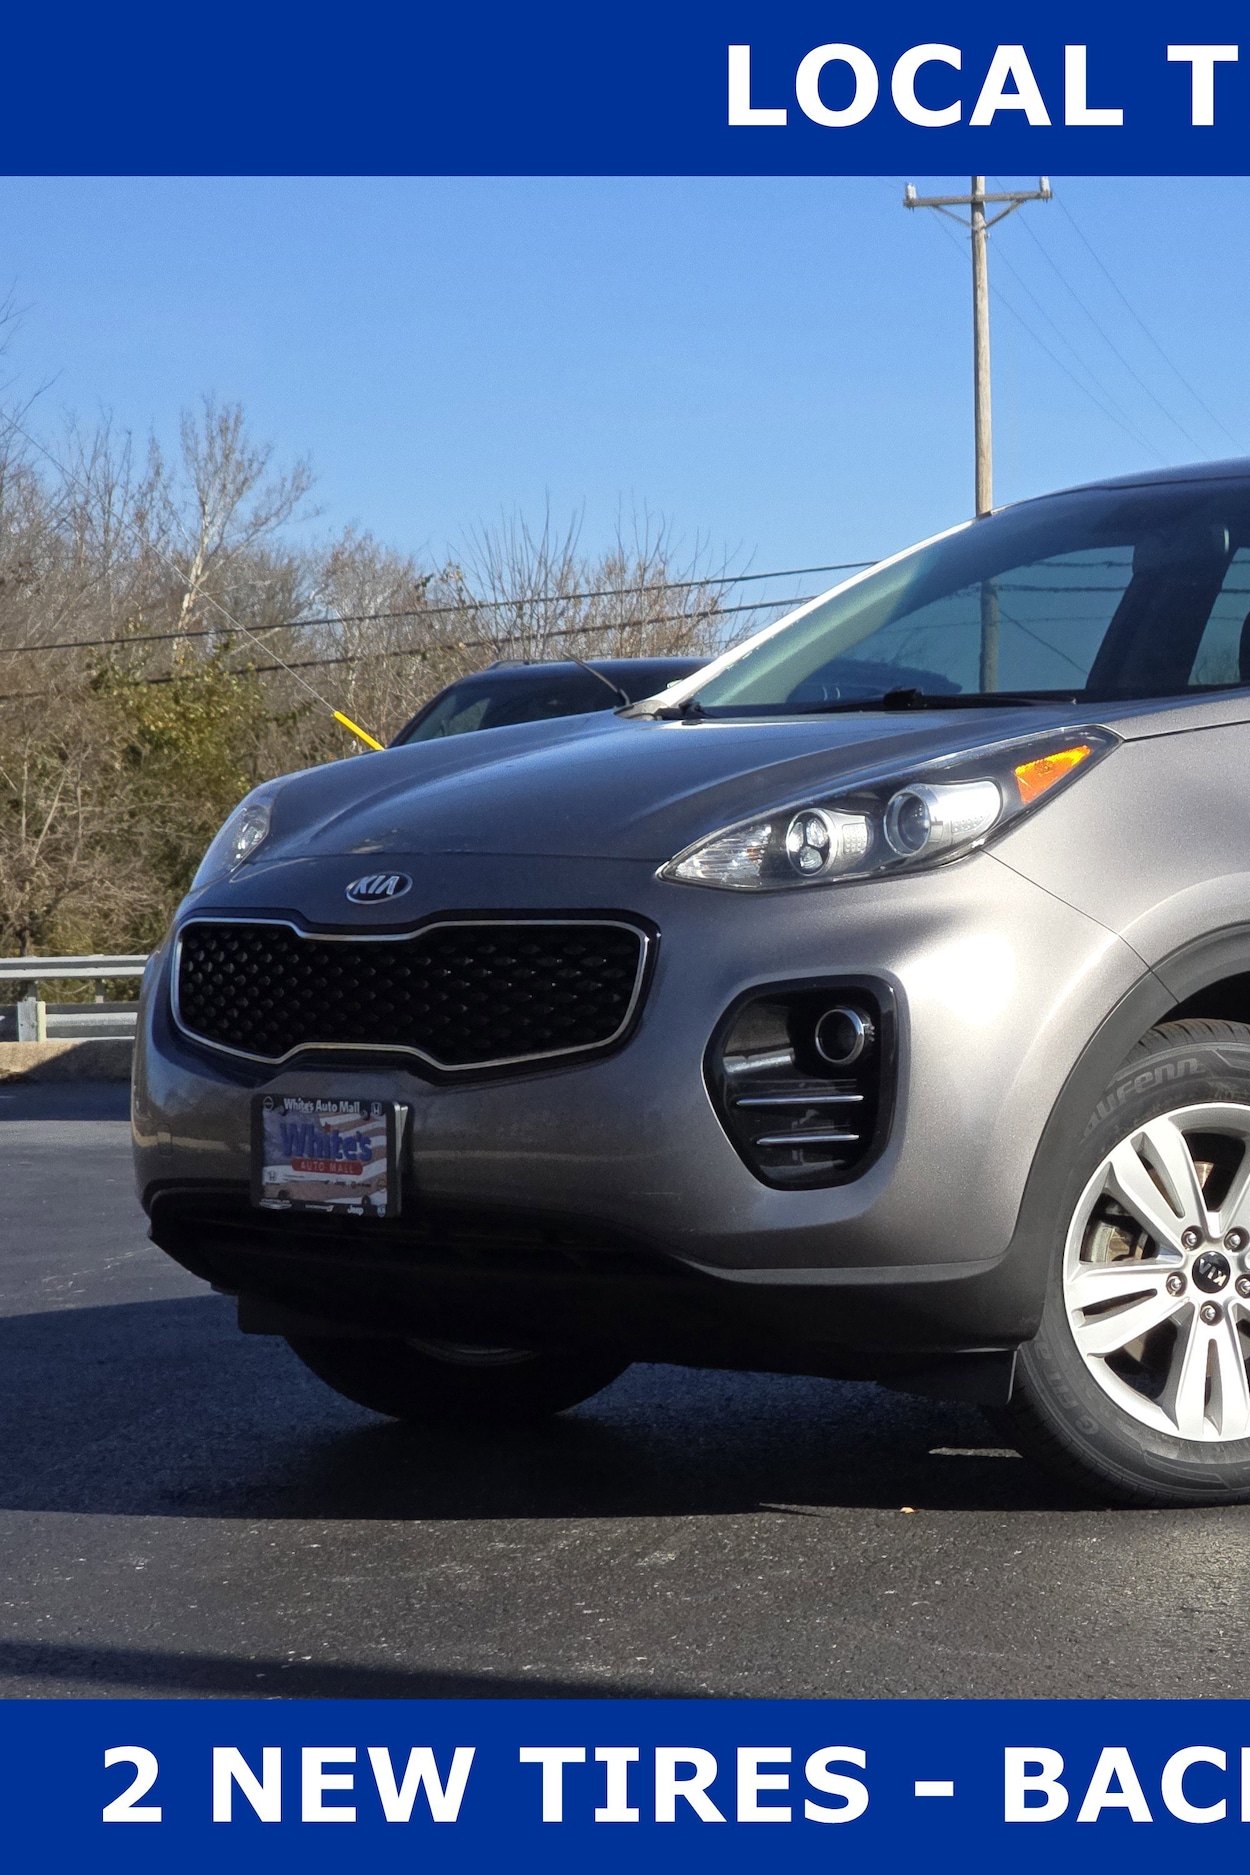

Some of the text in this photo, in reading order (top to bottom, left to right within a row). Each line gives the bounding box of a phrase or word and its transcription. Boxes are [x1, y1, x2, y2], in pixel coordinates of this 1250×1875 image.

[353, 875, 400, 895] KIA
[283, 1097, 360, 1114] White's Auto Mall
[279, 1121, 373, 1162] White's
[299, 1161, 354, 1174] AUTO MALL
[1198, 1259, 1227, 1287] KIA
